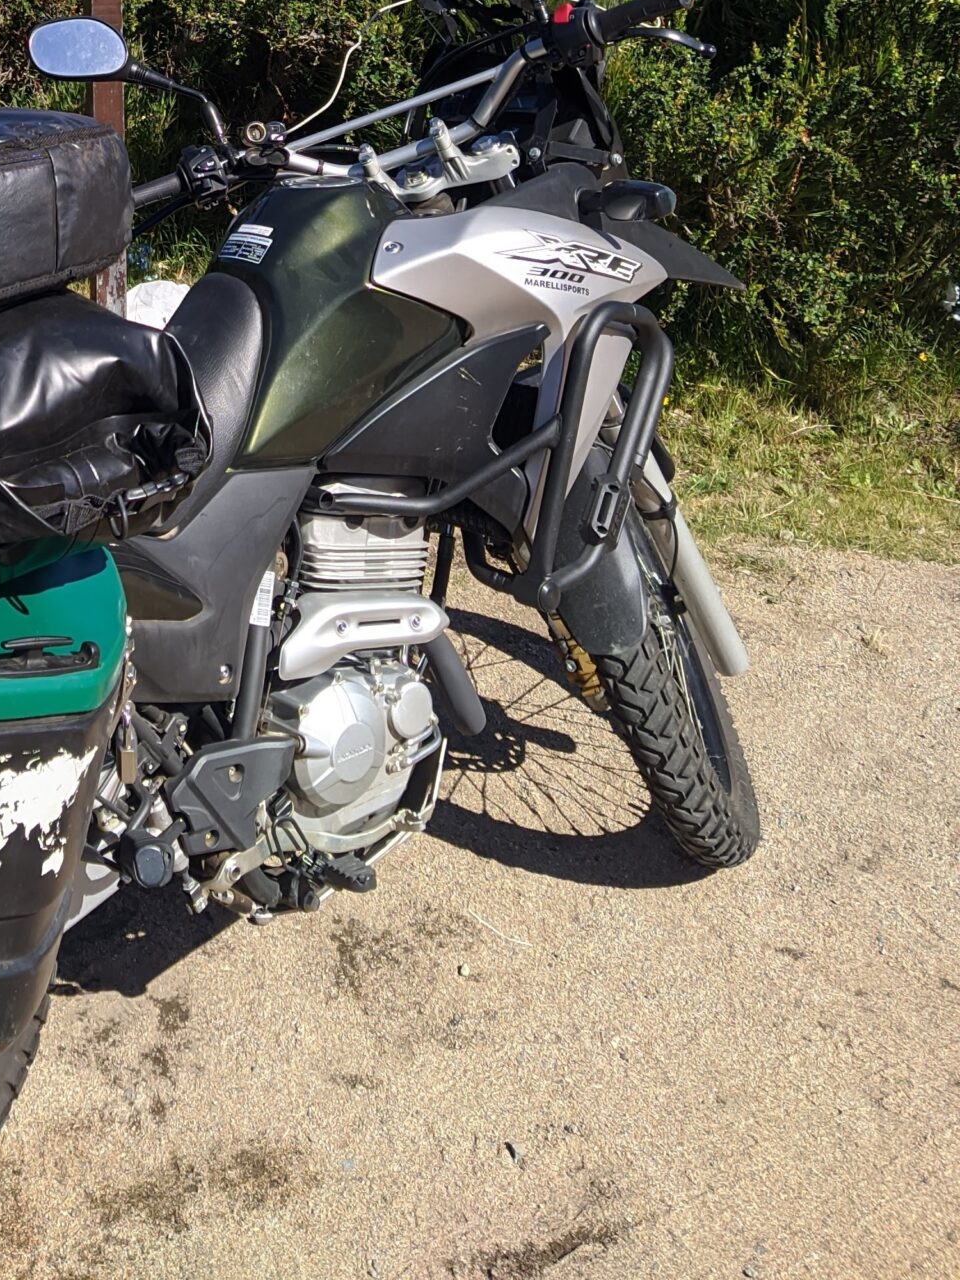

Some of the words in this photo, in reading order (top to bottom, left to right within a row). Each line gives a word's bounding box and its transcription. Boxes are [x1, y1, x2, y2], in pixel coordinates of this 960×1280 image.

[493, 228, 643, 284] XRE
[526, 266, 586, 284] 300
[524, 278, 590, 296] MARELLISPORTS
